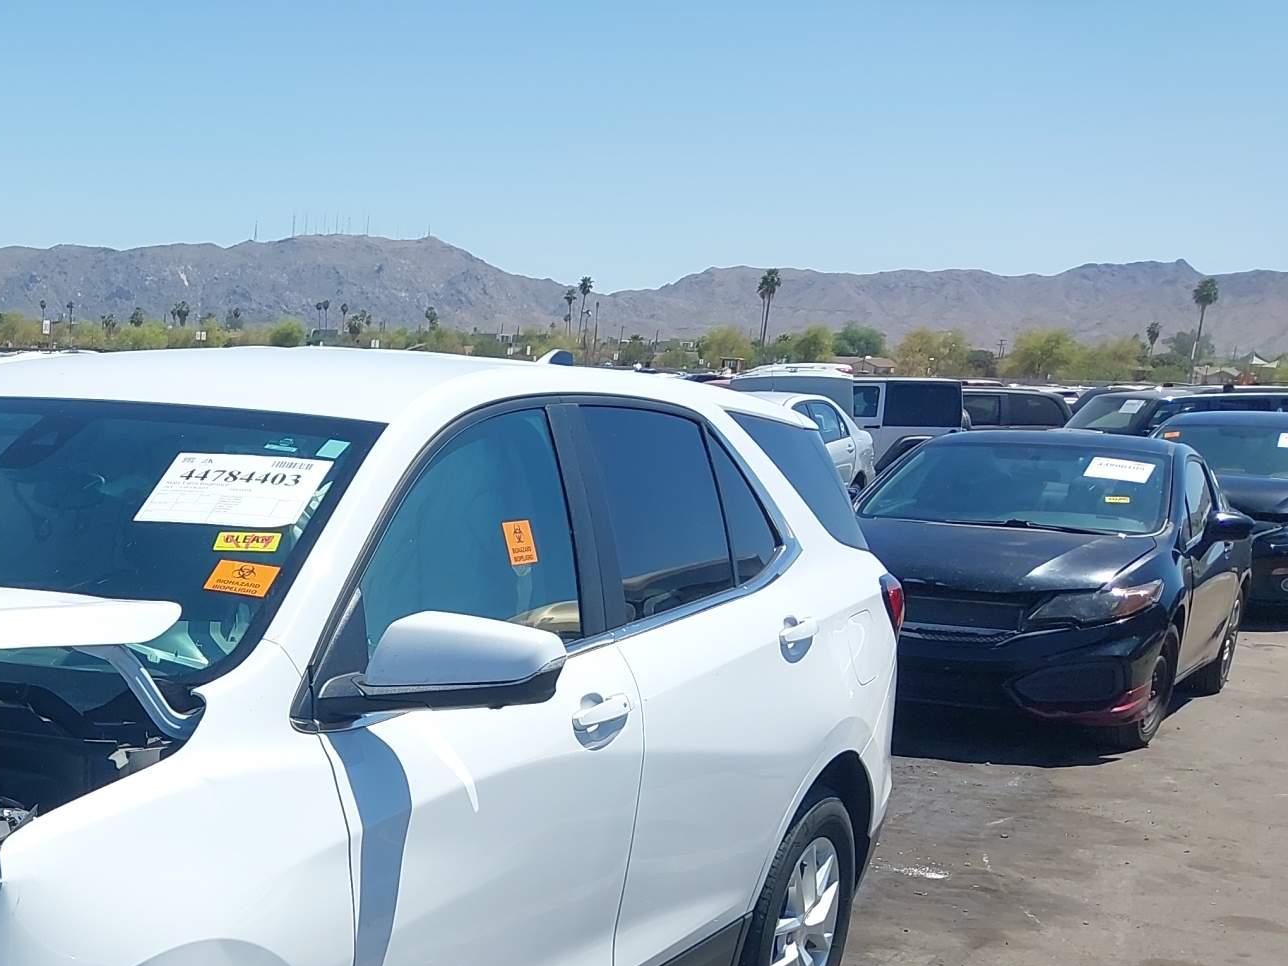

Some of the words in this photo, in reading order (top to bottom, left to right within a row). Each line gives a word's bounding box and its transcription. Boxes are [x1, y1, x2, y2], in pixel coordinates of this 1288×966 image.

[179, 468, 302, 487] 44784403
[216, 578, 261, 589] BIOHAZARD
[212, 584, 258, 595] BIOPELIGRO
